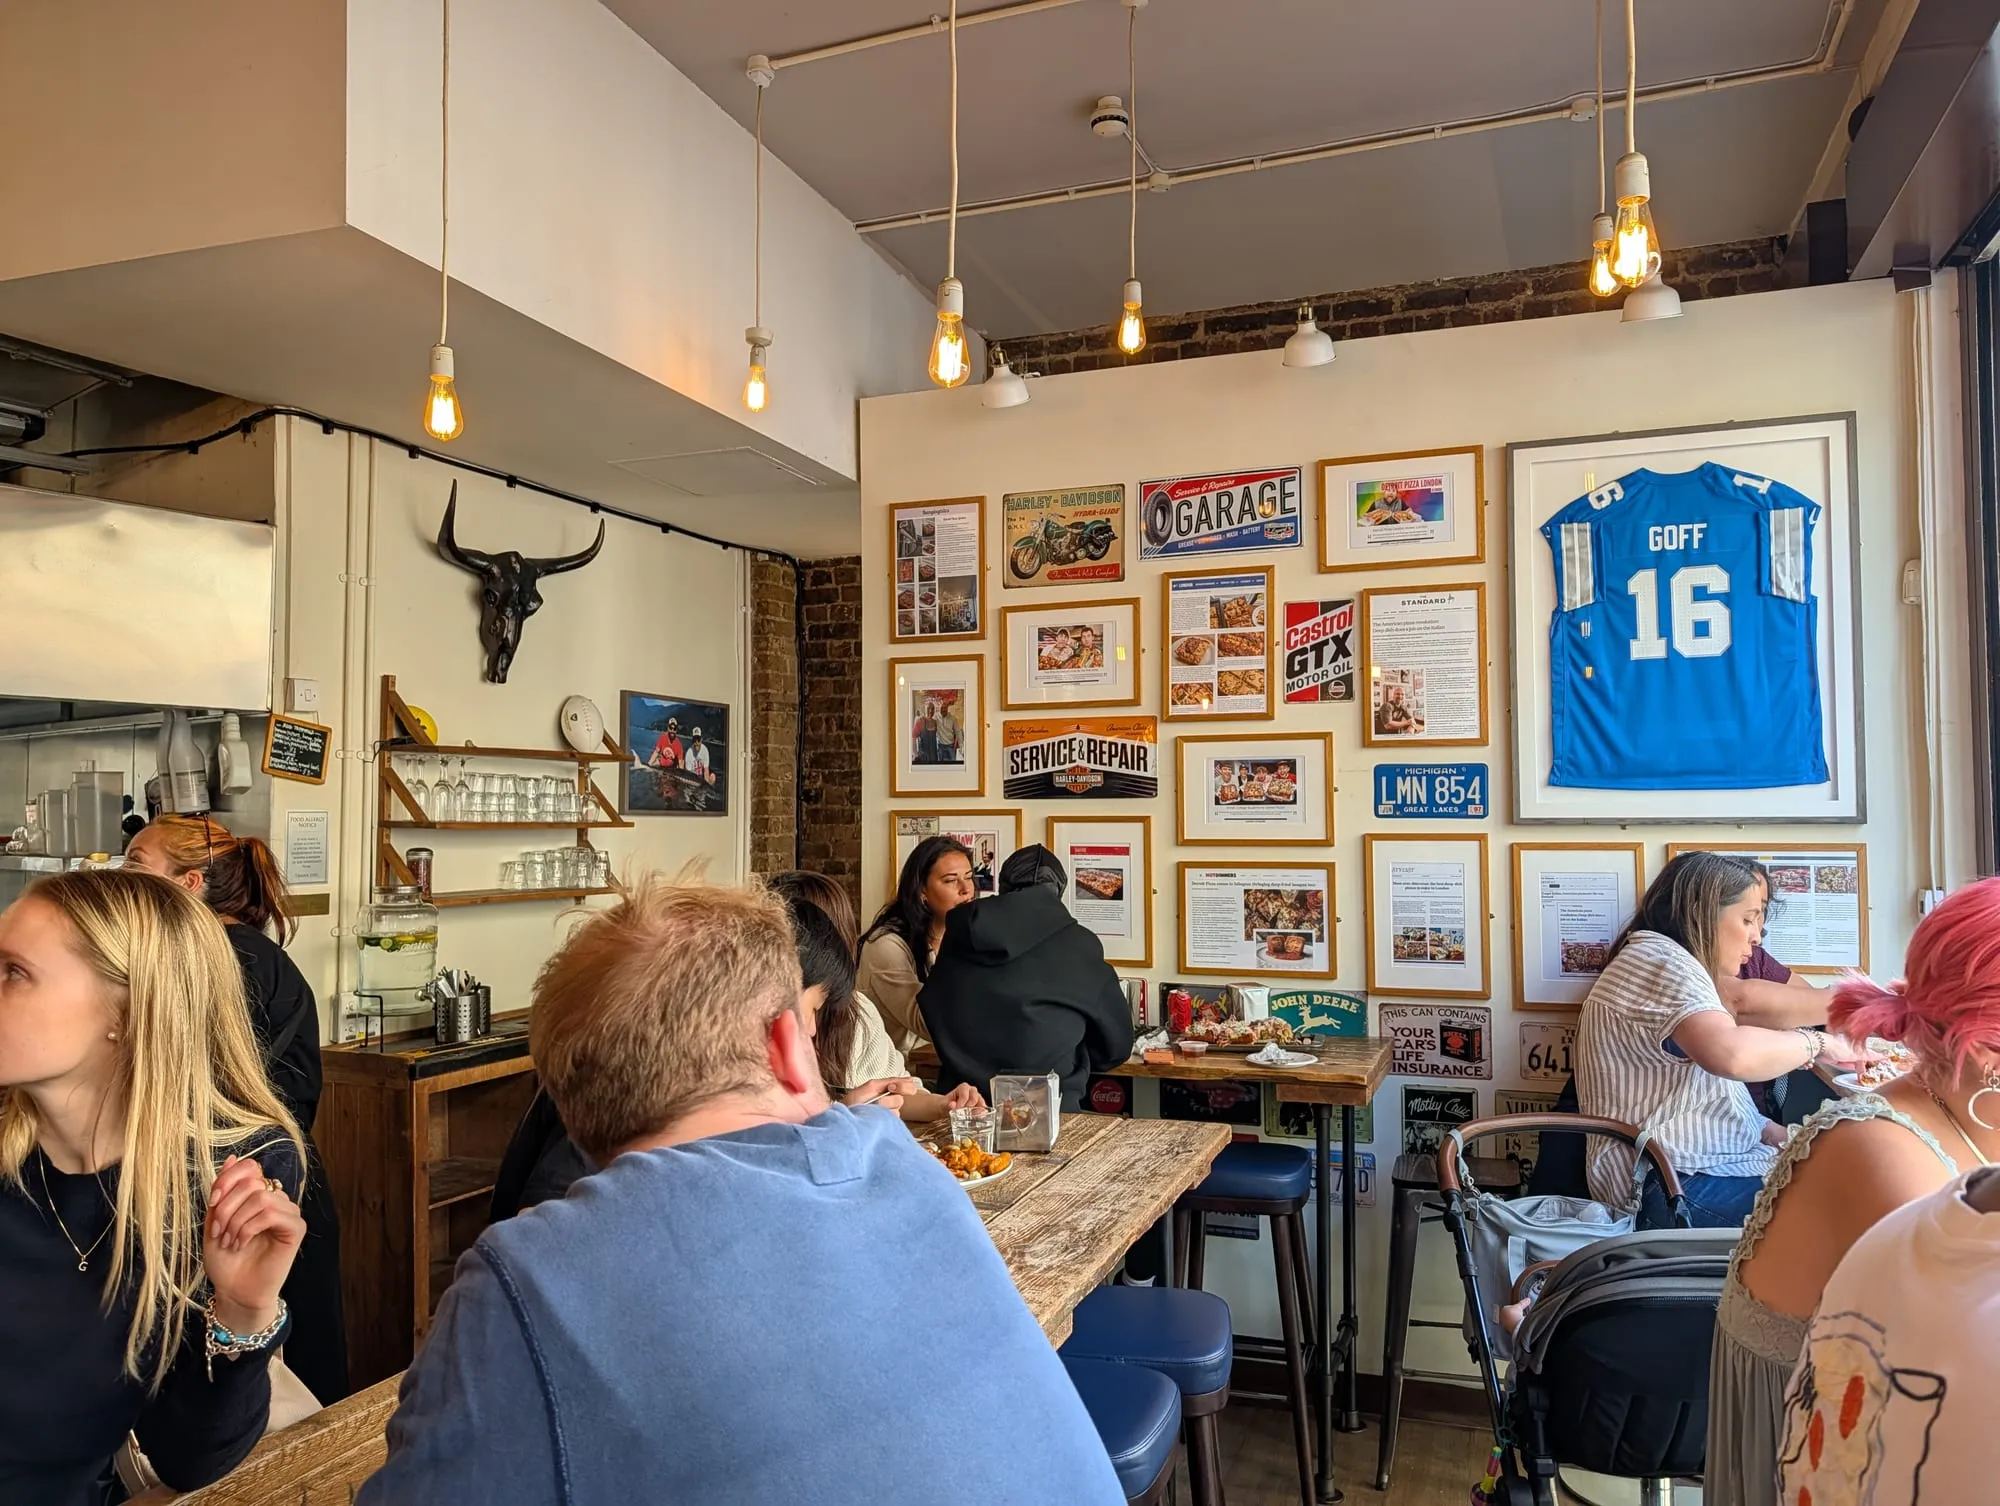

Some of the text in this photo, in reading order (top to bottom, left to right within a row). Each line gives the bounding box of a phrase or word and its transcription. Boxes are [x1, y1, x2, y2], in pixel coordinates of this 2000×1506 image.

[1404, 479, 1420, 489] PIZZA
[1421, 478, 1443, 488] LONDON
[1176, 476, 1297, 537] GARAGE
[1242, 526, 1260, 535] BATTERY
[1648, 522, 1707, 552] GOFF
[1401, 598, 1446, 606] STANDARD
[1627, 564, 1732, 661] 16
[1286, 604, 1353, 651] Castrol
[1286, 628, 1352, 679] GTX
[1286, 669, 1329, 693] MOTOR
[1333, 660, 1353, 675] OIL
[1010, 737, 1149, 776] SERVICE & REPAIR
[1404, 767, 1457, 775] MICHIGAN
[1381, 775, 1482, 805] LMN 854
[1271, 993, 1360, 1013] JOHN DEERE
[1384, 1007, 1487, 1024] THIS CAN CONTAINS
[1390, 1026, 1436, 1039] YOUR
[1393, 1039, 1437, 1051] CAR'S
[1393, 1051, 1425, 1062] LIFE
[1392, 1063, 1483, 1077] INSURANCE
